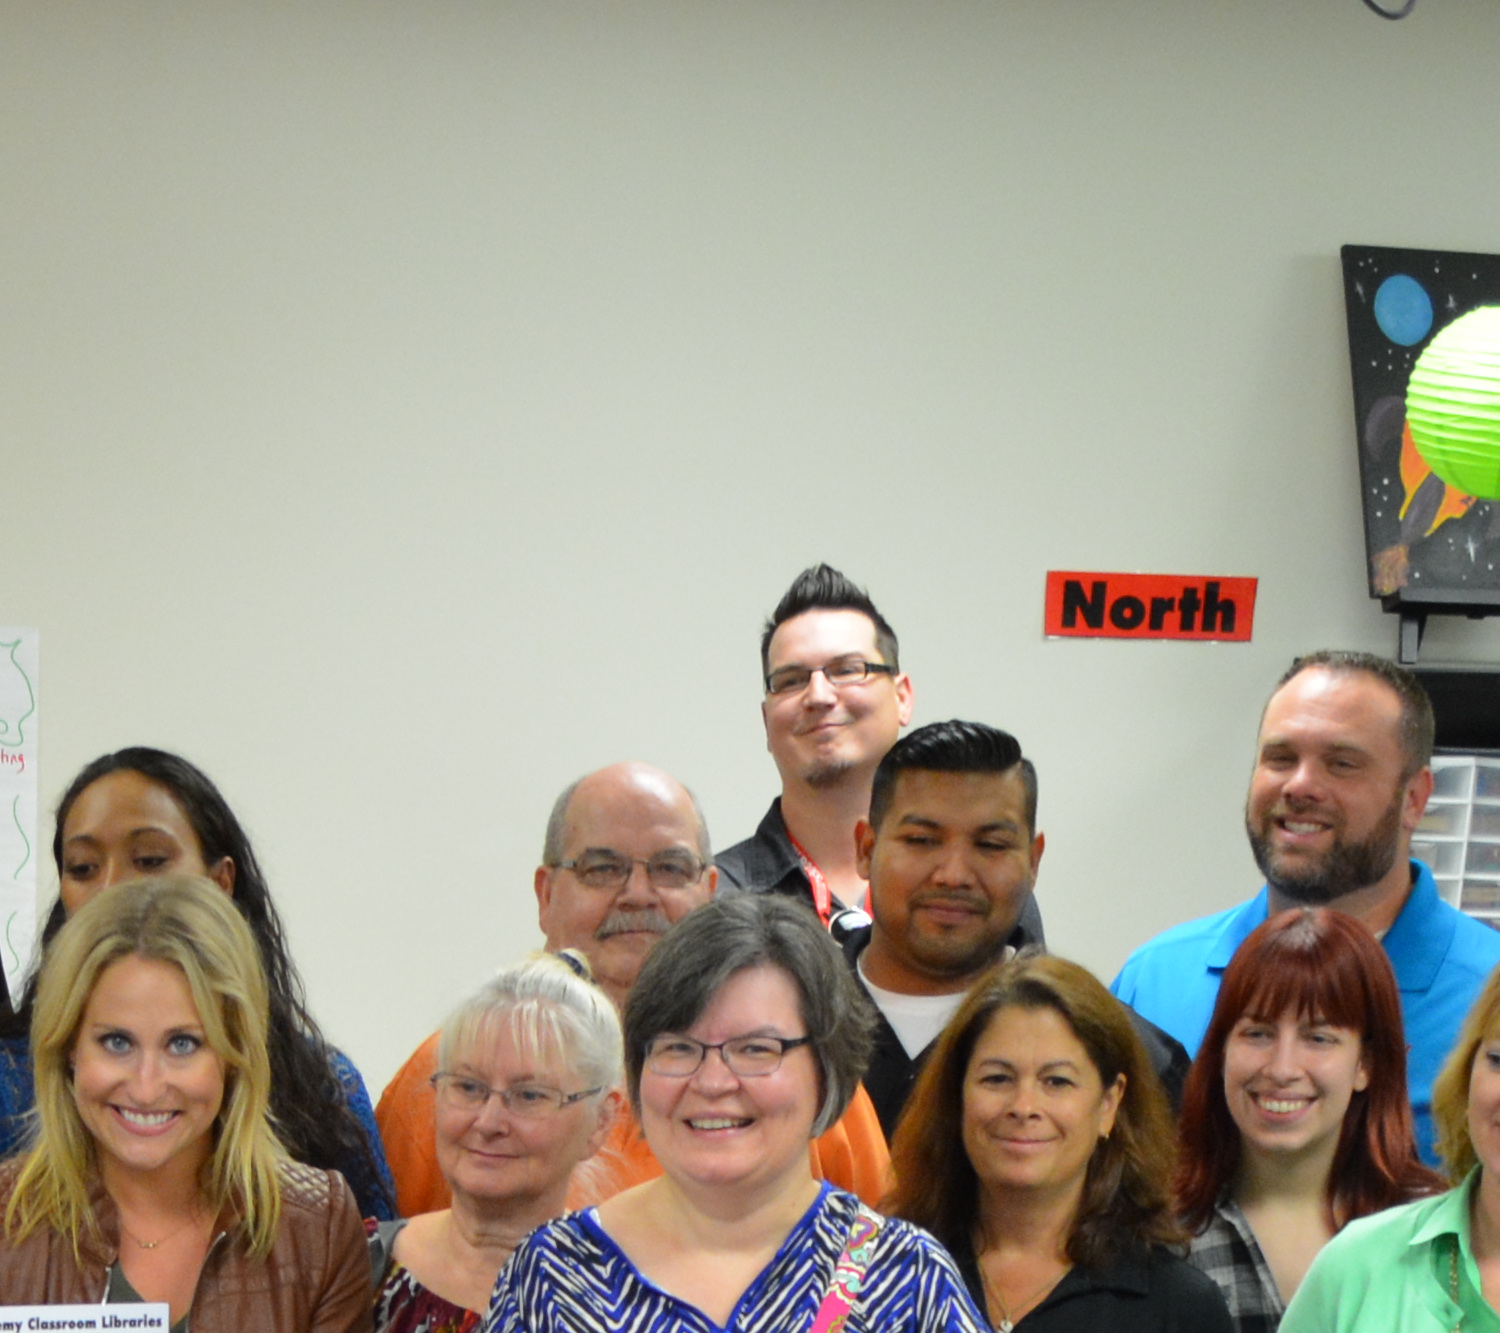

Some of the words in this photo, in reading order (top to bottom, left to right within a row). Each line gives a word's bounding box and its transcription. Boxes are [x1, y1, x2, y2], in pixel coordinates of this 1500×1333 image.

[1061, 580, 1236, 633] North
[27, 1316, 96, 1330] Classroom
[101, 1313, 163, 1329] Libraries
